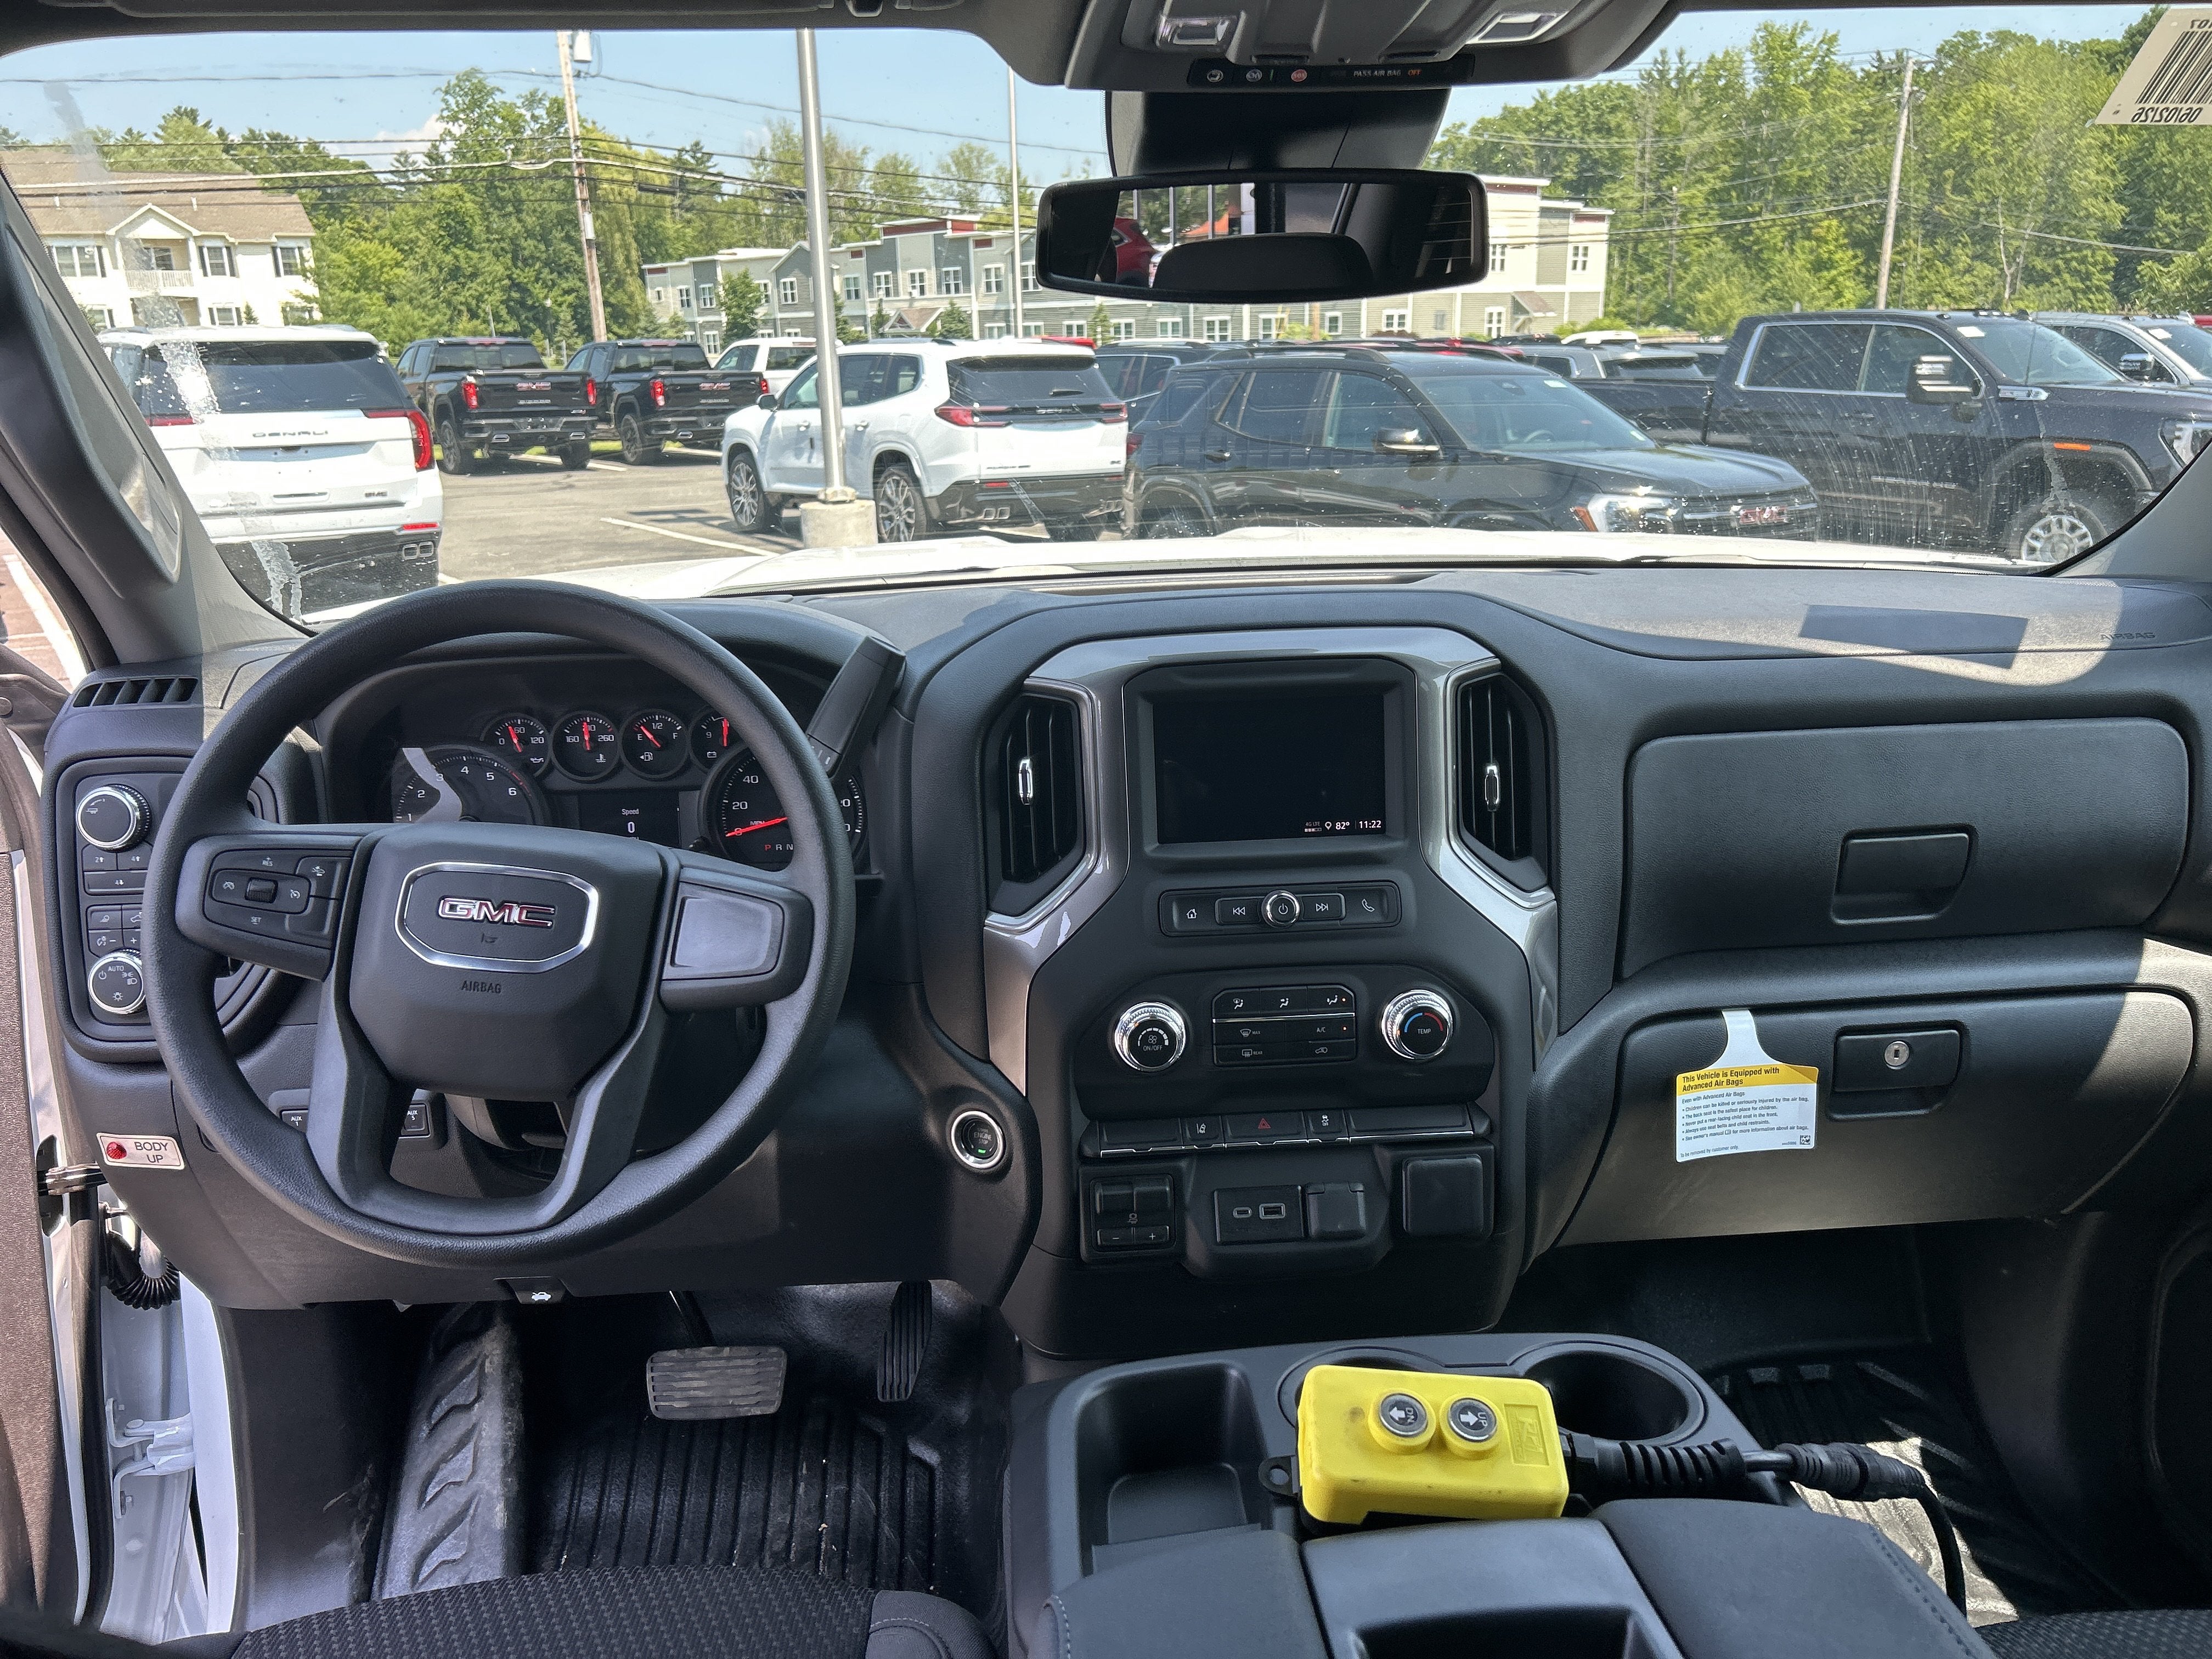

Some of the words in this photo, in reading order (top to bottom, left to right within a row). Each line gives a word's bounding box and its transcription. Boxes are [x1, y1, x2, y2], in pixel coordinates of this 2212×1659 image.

[2100, 631, 2155, 641] AIRBAG
[461, 766, 469, 774] 4
[436, 773, 444, 782] 3
[743, 775, 759, 783] 40
[417, 790, 425, 798] 2
[509, 787, 517, 795] 6
[732, 801, 748, 810] 20
[628, 821, 635, 833] 0
[1359, 820, 1381, 828] 11:22
[438, 897, 555, 927] GMC
[461, 980, 502, 994] AIRBAG
[1697, 1071, 1720, 1080] Vehicle
[1730, 1068, 1762, 1077] Equipped
[1683, 1081, 1712, 1092] Advanced
[974, 1132, 992, 1141] ENGINE
[134, 1142, 168, 1151] BODY
[146, 1154, 163, 1163] UP
[1405, 1407, 1415, 1423] DN
[1477, 1412, 1488, 1426] UP
